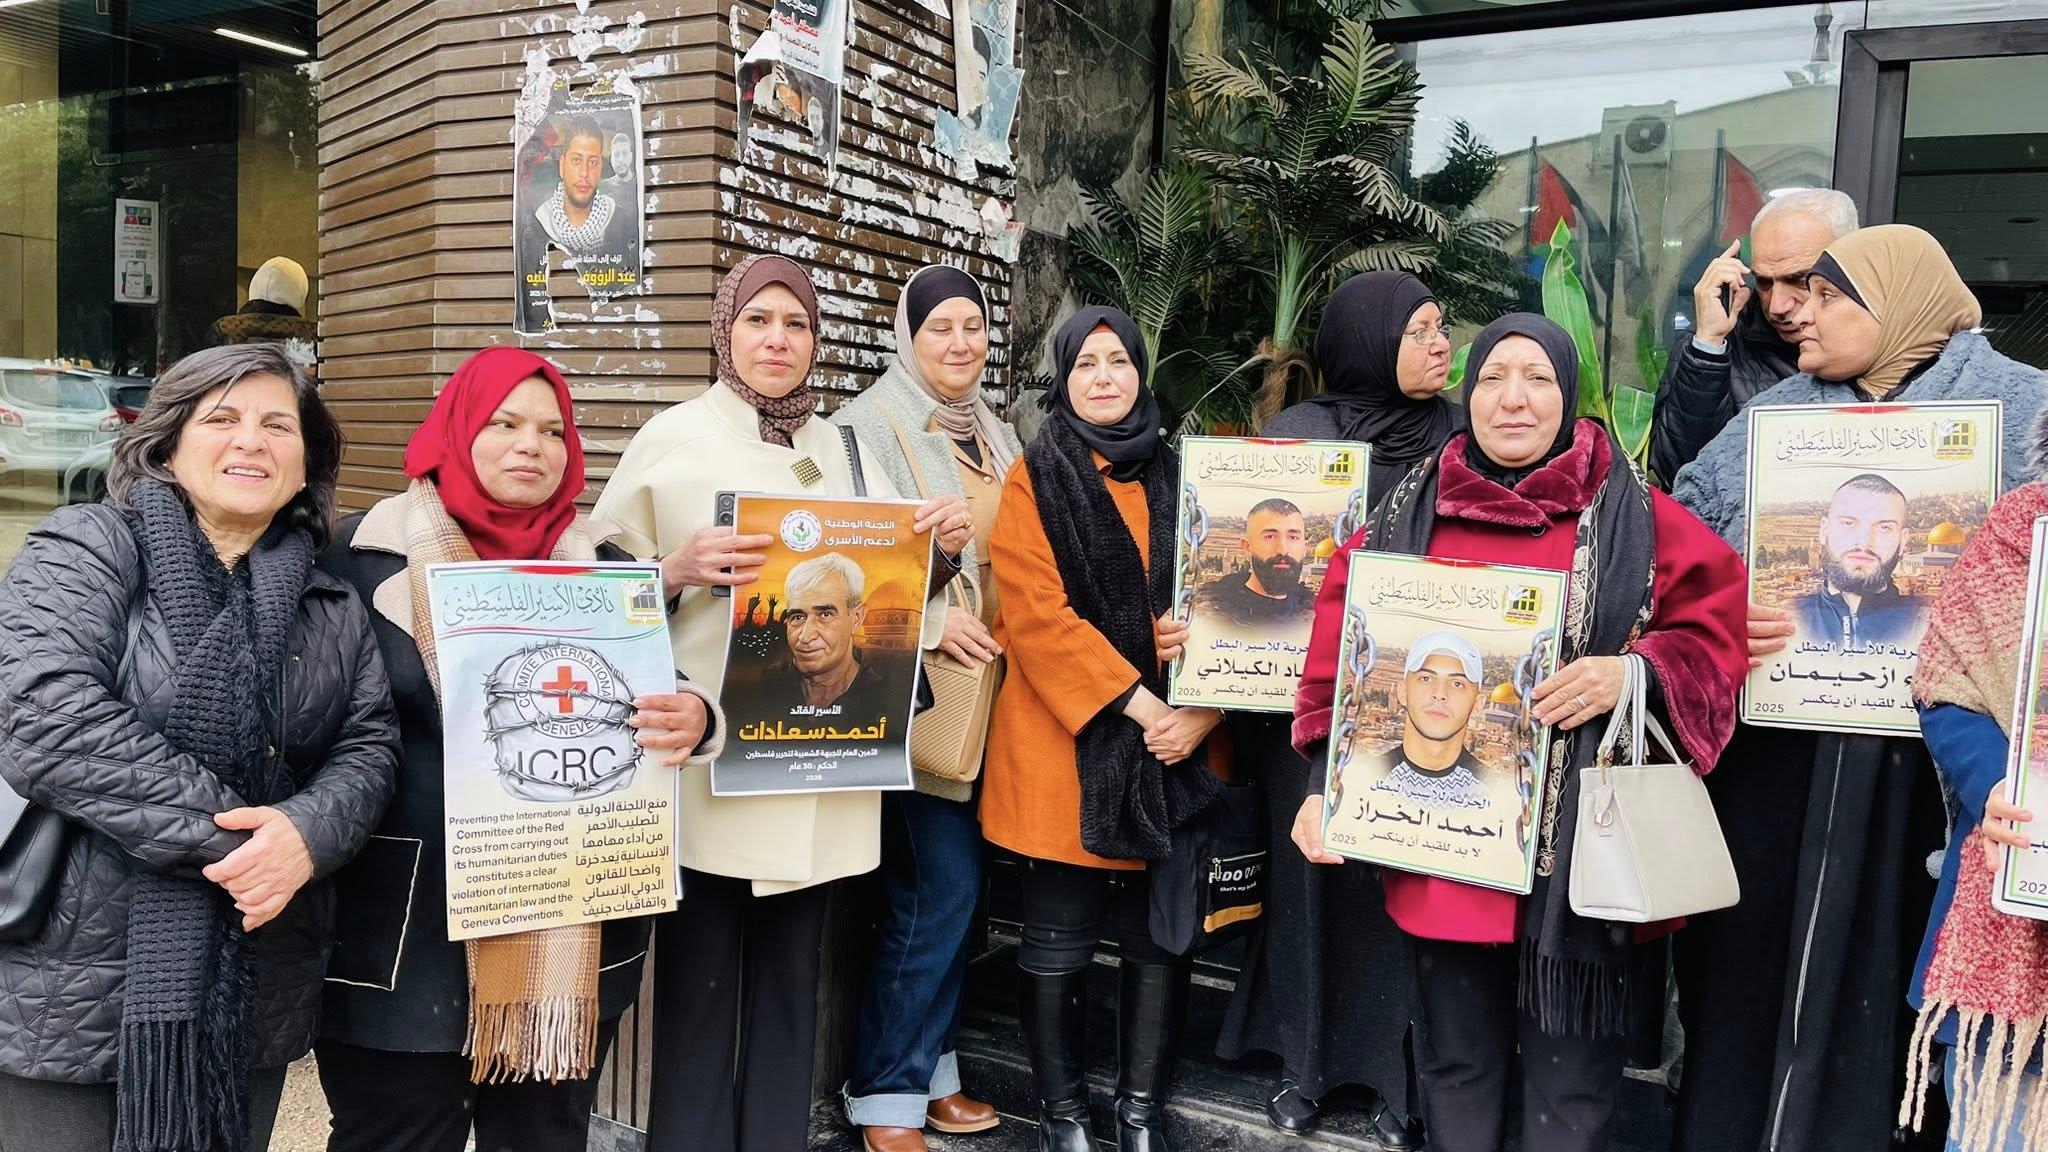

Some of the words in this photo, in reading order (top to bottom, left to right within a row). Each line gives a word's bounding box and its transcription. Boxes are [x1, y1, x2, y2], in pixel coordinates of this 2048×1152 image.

[824, 517, 863, 529] الوطنية
[864, 519, 895, 530] اللجنة
[863, 536, 896, 547] لدعم
[1210, 639, 1242, 652] البطل
[1795, 640, 1836, 656] البطل
[540, 646, 612, 705] INTERNATIONA
[1197, 656, 1278, 680] الكيلاني
[1177, 686, 1202, 697] 2026
[789, 704, 815, 715] القائد
[815, 704, 842, 717] الأسير
[1754, 701, 1785, 714] 2025
[1861, 698, 1895, 710] للقيد
[738, 720, 826, 741] سعادات
[825, 716, 887, 740] أحمد
[517, 745, 617, 787] ICRC
[817, 761, 838, 772] الحكم
[577, 802, 615, 817] الدولية
[615, 798, 647, 814] اللجنة
[647, 798, 668, 814] منع
[1352, 797, 1431, 826] الخراز
[449, 814, 499, 825] Preventing
[500, 812, 515, 821] the
[516, 808, 571, 821] International
[618, 814, 660, 831] للصليب
[456, 827, 514, 840] Committee
[516, 825, 526, 835] of
[527, 825, 544, 834] the
[545, 822, 565, 832] Red
[585, 817, 618, 834] الأحمر
[1437, 816, 1504, 841] أحمد
[582, 836, 625, 849] مهامها
[626, 828, 645, 845] أداء
[646, 832, 664, 845] من
[1330, 831, 1358, 846] 2025
[452, 844, 483, 855] Cross
[484, 842, 509, 852] from
[510, 840, 552, 850] carrying
[553, 837, 569, 846] out
[1421, 840, 1451, 852] للقيد
[454, 860, 467, 870] its
[468, 853, 537, 868] humanitarian
[538, 851, 568, 861] duties
[466, 870, 524, 884] constitutes
[525, 870, 532, 878] a
[532, 867, 558, 877] clear
[585, 866, 628, 885] للقانون
[451, 887, 496, 900] violation
[497, 885, 507, 895] of
[508, 878, 571, 894] international
[631, 878, 664, 899] الدولي
[2018, 880, 2048, 896] 202
[449, 900, 518, 916] humanitarian
[519, 897, 538, 908] law
[538, 894, 557, 905] and
[558, 893, 574, 903] the
[582, 903, 612, 918] جنيف
[613, 895, 667, 913] واتفاقيات
[461, 917, 501, 930] Geneva
[502, 909, 564, 924] Conventions
